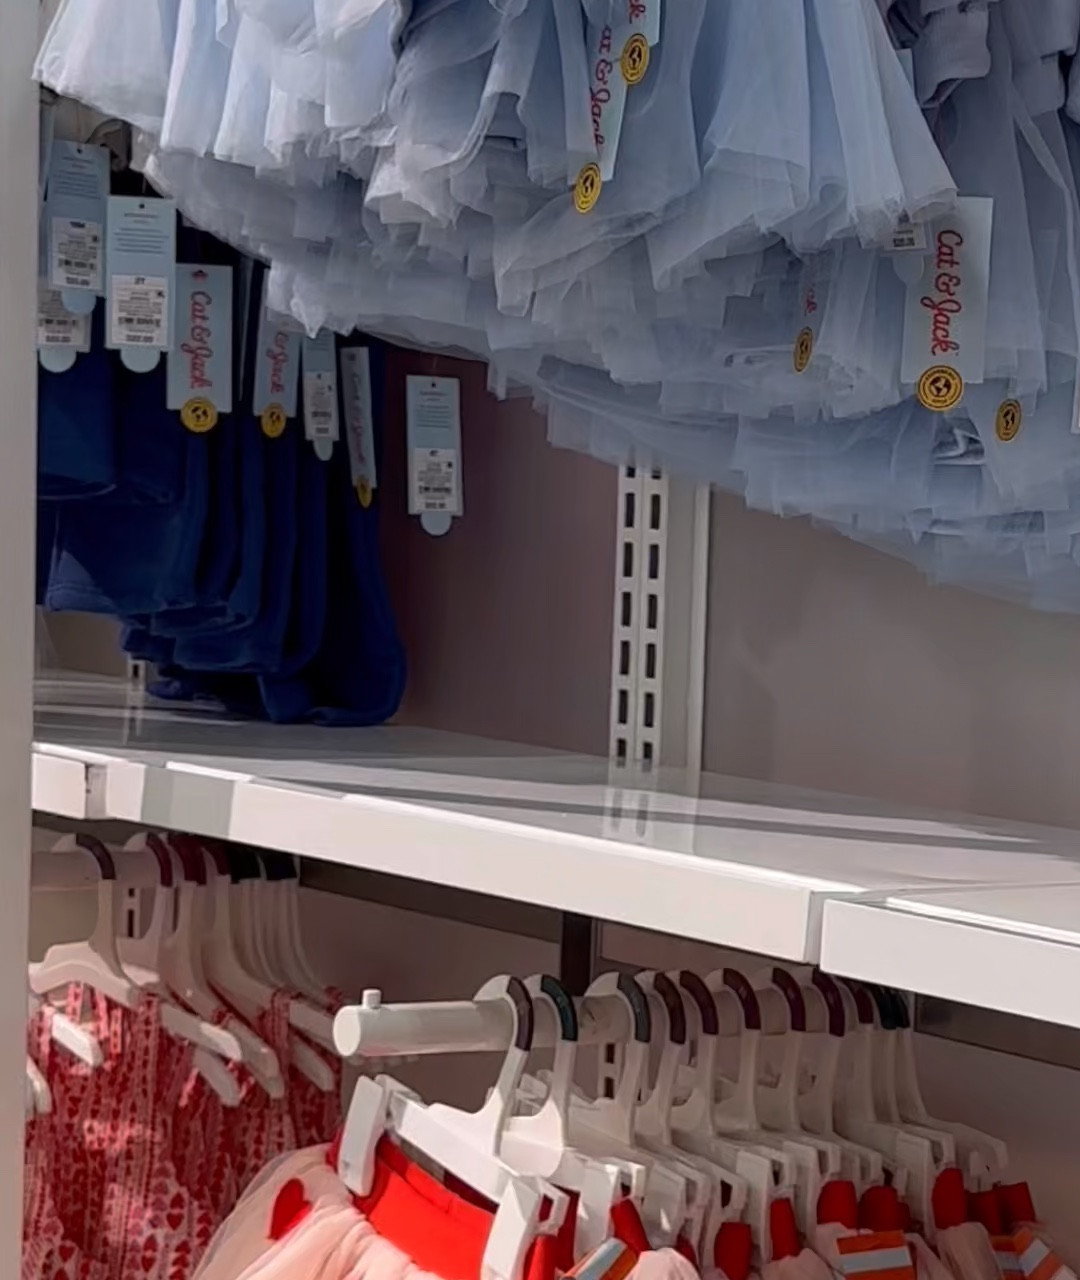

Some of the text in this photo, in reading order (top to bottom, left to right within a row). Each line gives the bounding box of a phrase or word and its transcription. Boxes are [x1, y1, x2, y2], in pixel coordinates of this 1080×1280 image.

[936, 228, 964, 269] Cat
[934, 272, 961, 296] &
[920, 295, 962, 357] Jack
